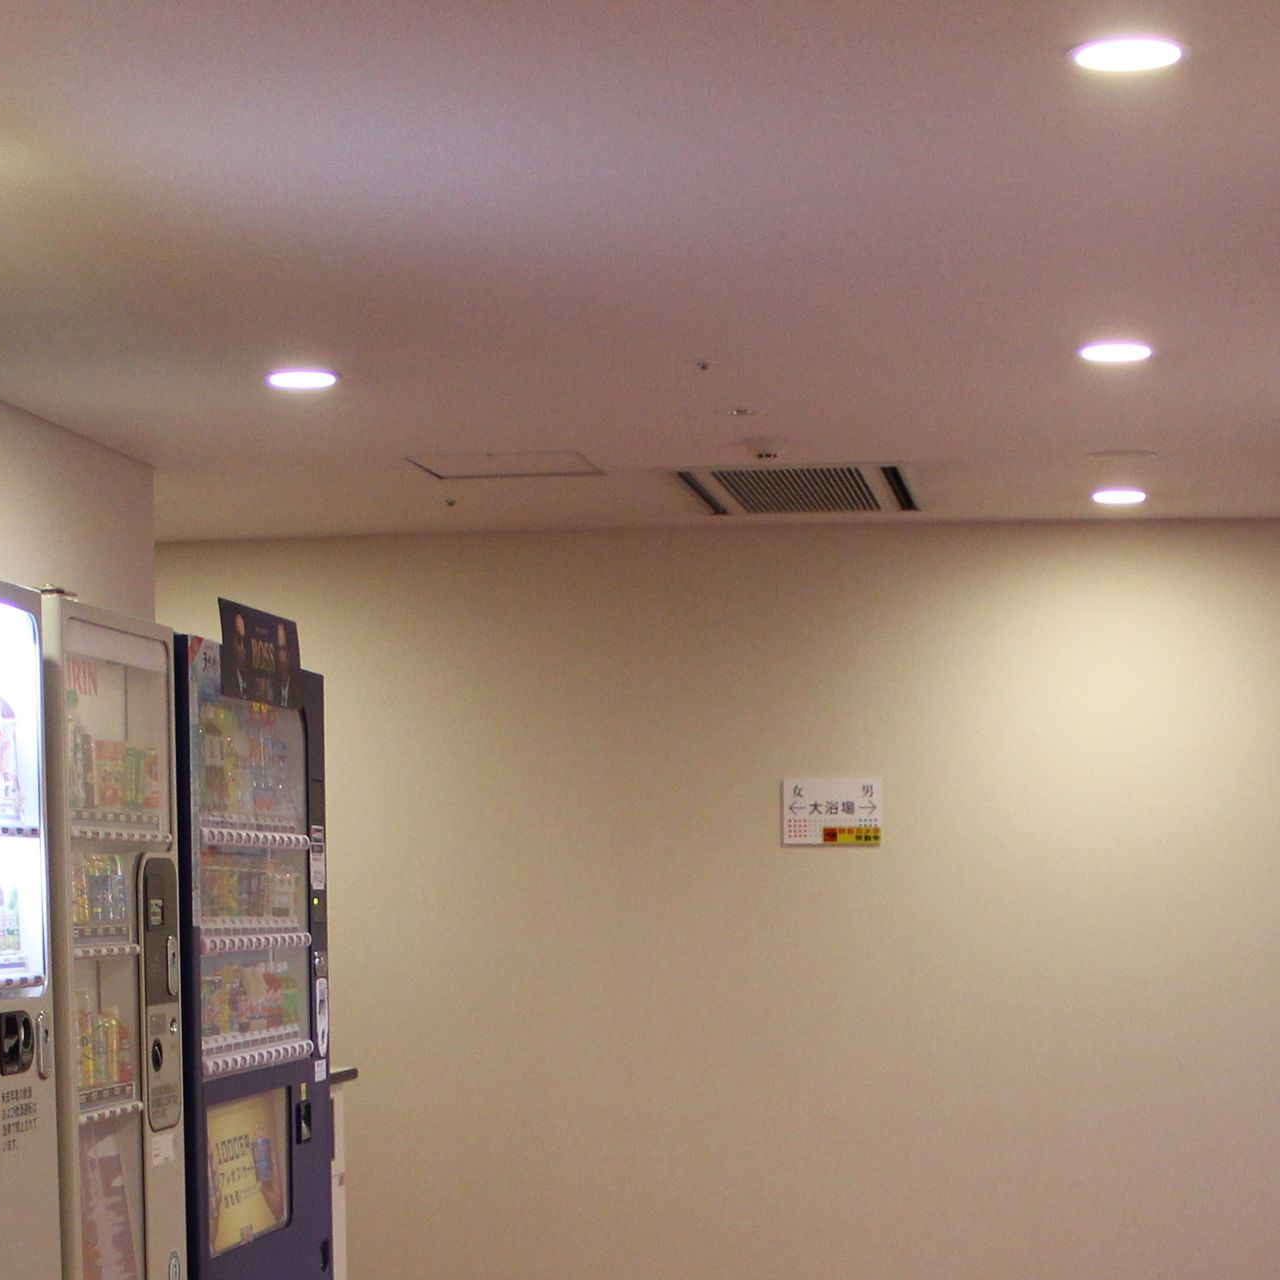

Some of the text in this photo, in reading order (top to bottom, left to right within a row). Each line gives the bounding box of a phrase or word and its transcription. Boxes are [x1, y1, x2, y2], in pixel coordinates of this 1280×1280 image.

[251, 638, 276, 673] BOSS
[67, 657, 98, 696] IRIN
[793, 784, 874, 798] 女 男
[809, 800, 856, 815] 大浴場
